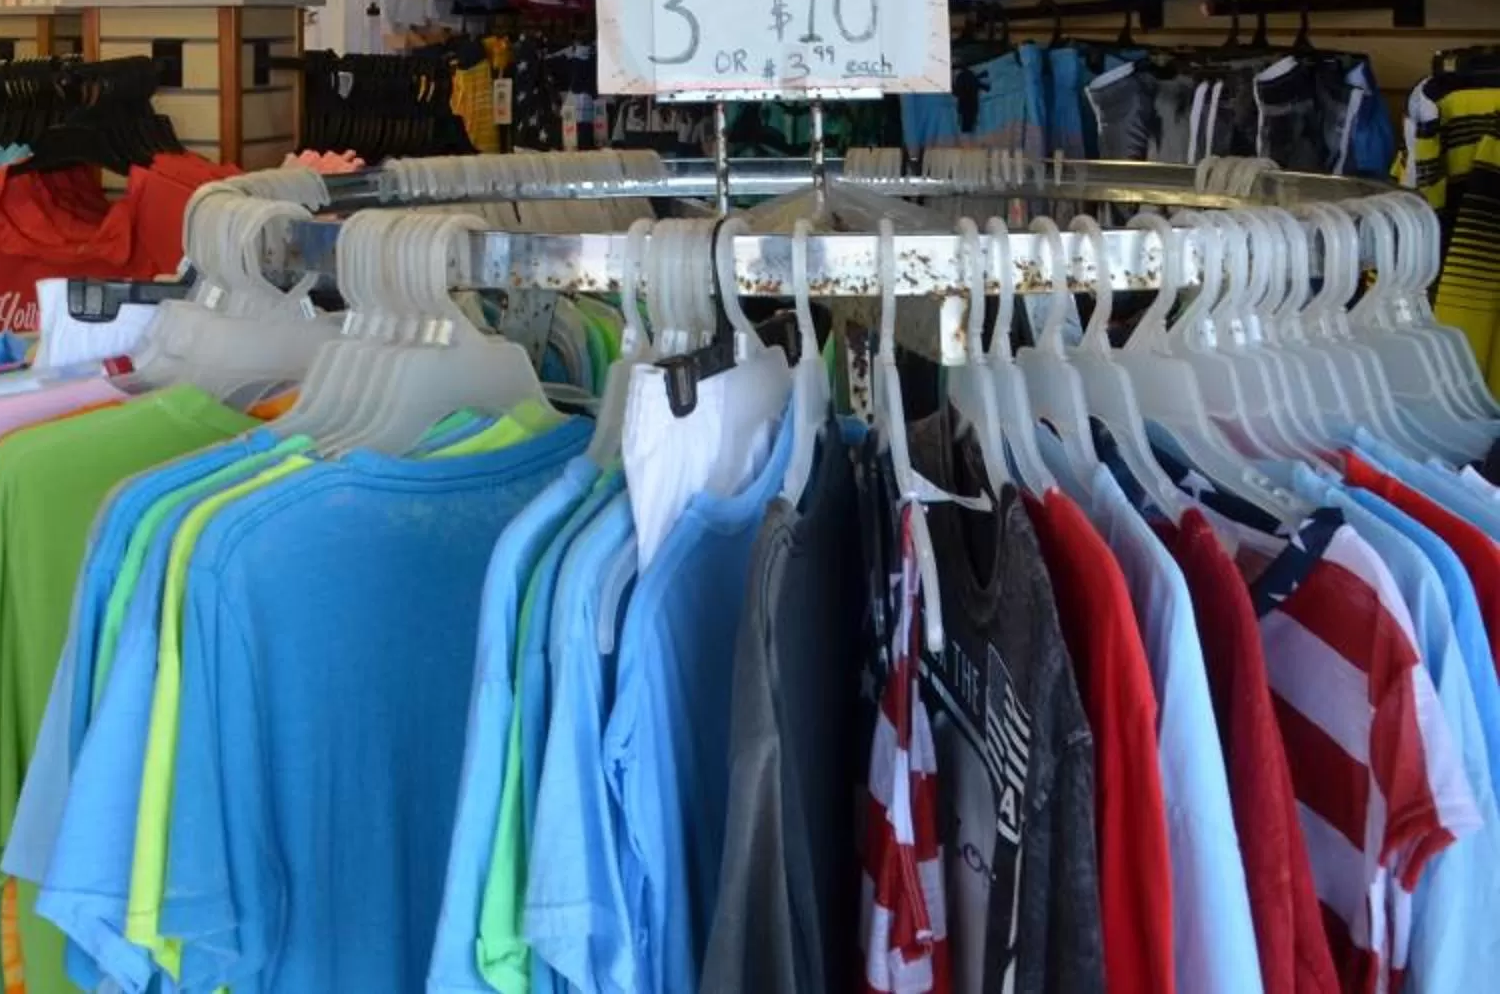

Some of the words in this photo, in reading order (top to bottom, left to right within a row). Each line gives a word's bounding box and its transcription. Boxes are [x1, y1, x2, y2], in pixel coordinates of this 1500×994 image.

[714, 49, 749, 75] OR
[844, 52, 894, 75] each
[951, 639, 981, 717] THE
